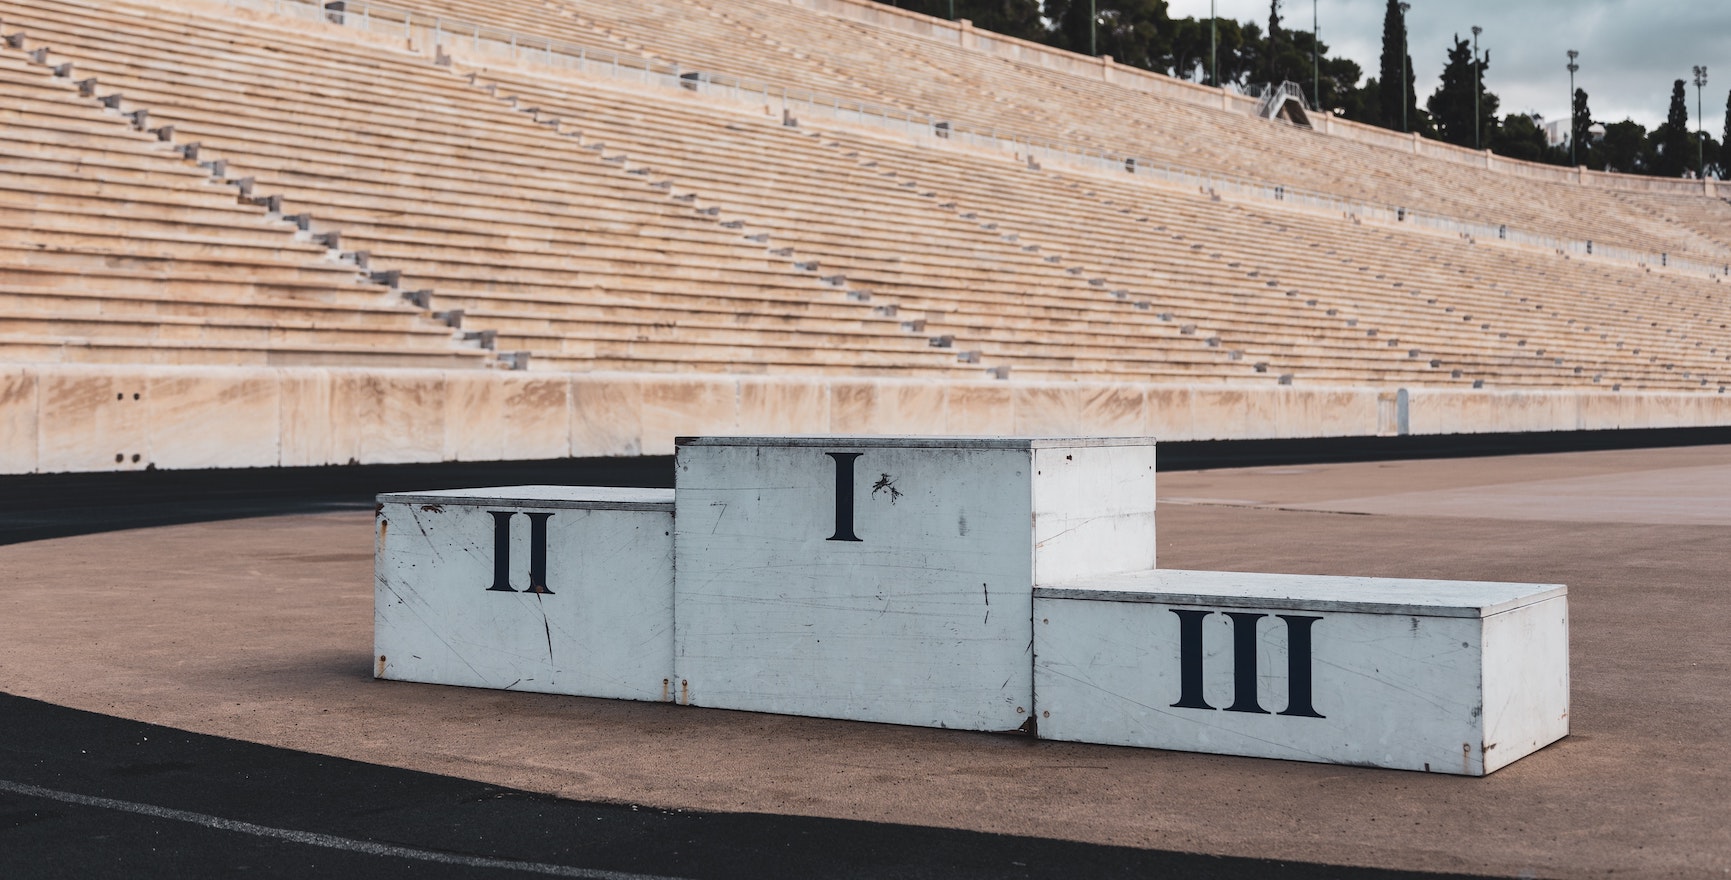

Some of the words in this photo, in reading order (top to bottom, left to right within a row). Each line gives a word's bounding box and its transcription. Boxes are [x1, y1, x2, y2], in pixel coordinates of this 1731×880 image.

[826, 452, 863, 542] I
[486, 510, 556, 595] II
[1168, 608, 1327, 719] III
